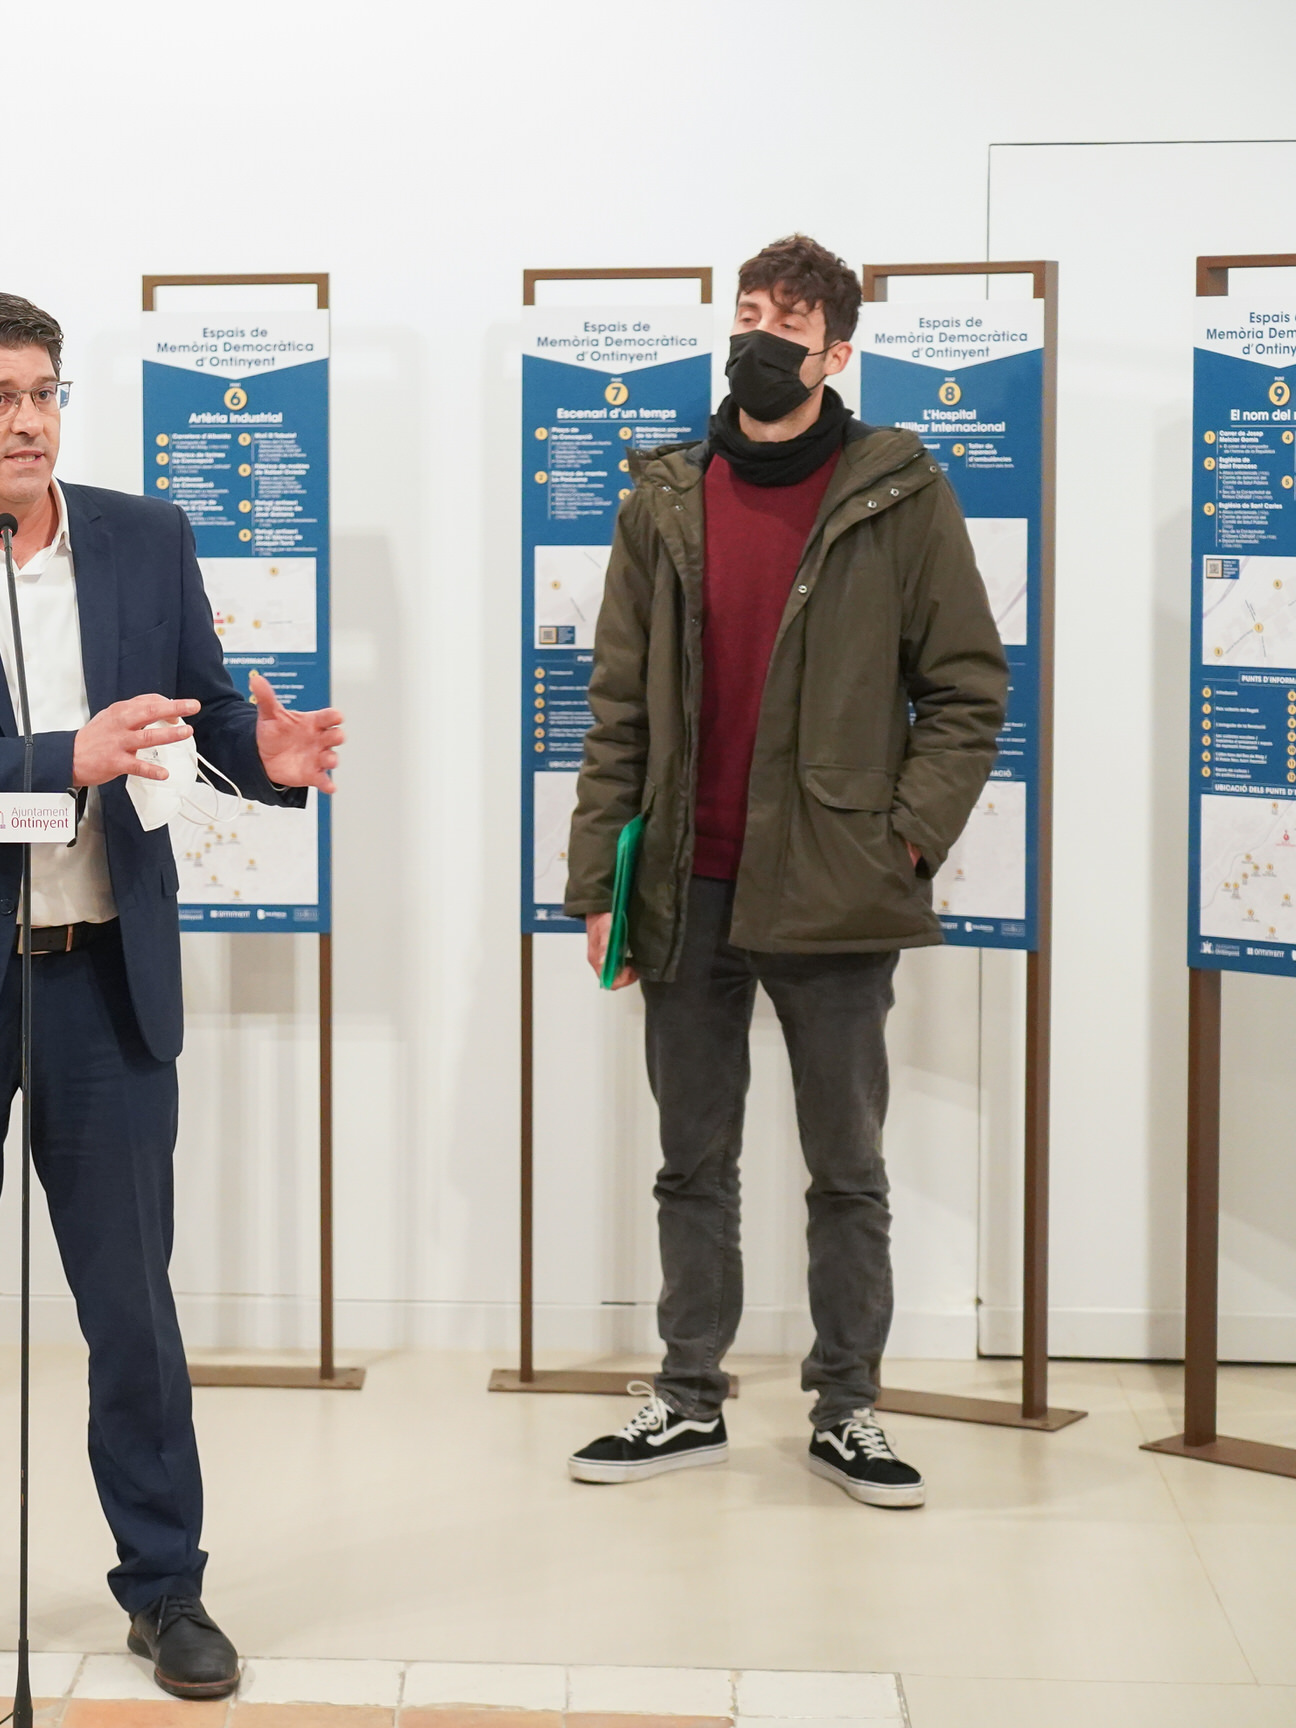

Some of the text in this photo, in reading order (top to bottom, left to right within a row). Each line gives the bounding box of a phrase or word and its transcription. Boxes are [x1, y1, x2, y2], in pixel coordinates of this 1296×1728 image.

[919, 317, 983, 330] Espais de
[1250, 312, 1290, 325] Espais
[203, 328, 268, 340] Espais de
[584, 322, 650, 334] Espais de
[1206, 327, 1263, 339] Memòria
[537, 335, 697, 347] Memòria Democràtica
[875, 331, 1028, 344] Memòria Democràtica
[157, 341, 314, 352] Memòria Democràtica
[912, 347, 990, 359] d'Ontinyent
[230, 392, 241, 405] 6
[611, 387, 621, 401] 7
[945, 386, 955, 401] 8
[1274, 386, 1285, 402] 9
[189, 412, 282, 424] Artèria Industrial
[557, 408, 676, 420] Escenari d'un temps
[923, 409, 976, 421] L'Hospital
[1230, 409, 1290, 421] El nom del
[931, 421, 1005, 432] Internacional
[1242, 675, 1262, 683] PUNTS
[1215, 784, 1247, 792] UBICACIÓ
[1266, 787, 1286, 795] PUNTS
[12, 808, 68, 817] Ajuntament
[12, 817, 68, 831] Ontinyent
